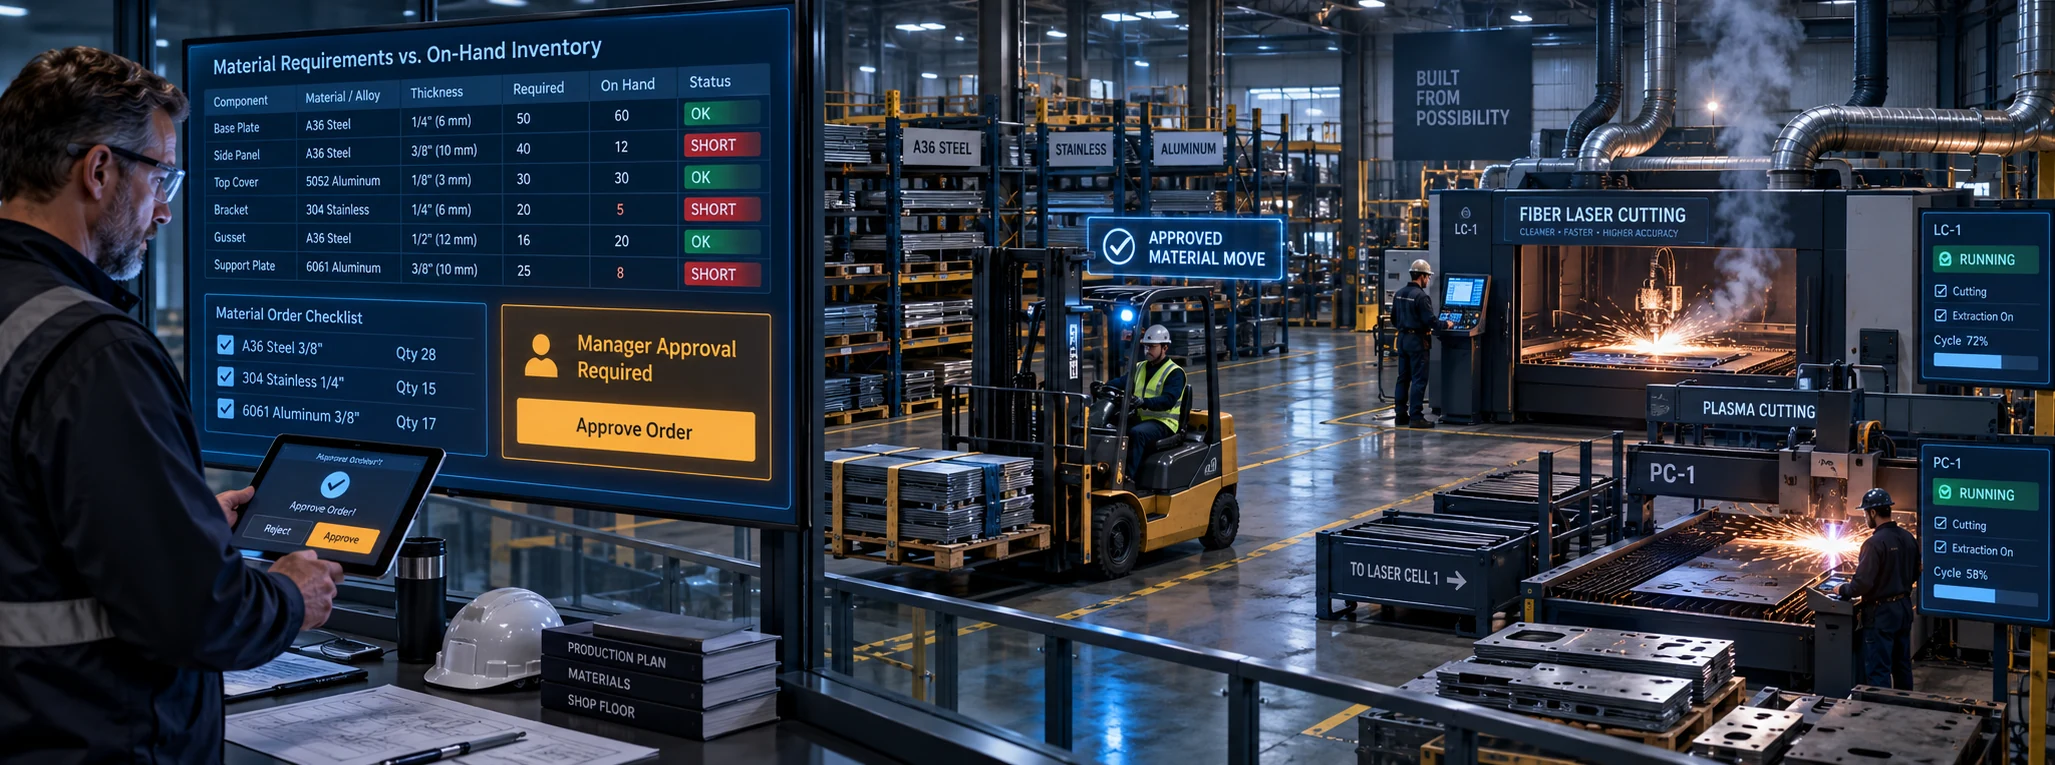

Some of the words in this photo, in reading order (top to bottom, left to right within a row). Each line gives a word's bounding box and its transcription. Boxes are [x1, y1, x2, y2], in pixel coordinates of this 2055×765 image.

[213, 56, 276, 75] Material
[282, 50, 393, 73] Requirements
[399, 51, 421, 64] vs.
[427, 41, 505, 62] On-Hand
[513, 39, 602, 58] Inventory
[601, 80, 618, 91] On
[623, 77, 655, 90] Hand
[690, 76, 731, 88] Status
[1417, 70, 1459, 86] BUILT
[411, 87, 463, 98] Thickness
[514, 81, 564, 97] Required
[214, 96, 268, 108] Component
[306, 91, 345, 103] Material
[348, 90, 353, 102] /
[356, 90, 380, 103] Alloy
[1417, 90, 1459, 105] FROM
[517, 113, 530, 124] 50
[615, 110, 629, 121] 60
[692, 107, 710, 119] OK
[1417, 109, 1509, 126] POSSIBILITY
[214, 123, 235, 133] Base
[237, 121, 260, 133] Plate
[306, 120, 324, 130] A36
[327, 118, 350, 130] Steel
[436, 116, 445, 128] (6
[448, 114, 471, 127] mm)
[436, 145, 451, 158] (10
[454, 143, 477, 157] mm)
[517, 143, 530, 154] 40
[616, 141, 627, 152] 12
[692, 139, 736, 151] SHORT
[914, 140, 935, 153] A36
[940, 141, 971, 154] STEEL
[1056, 143, 1106, 155] STAINLESS
[1162, 143, 1215, 154] ALUMINUM
[214, 150, 233, 160] Side
[236, 149, 260, 160] Panel
[306, 148, 324, 158] A36
[327, 147, 350, 158] Steel
[307, 176, 329, 186] 5052
[332, 175, 380, 186] Aluminum
[435, 174, 445, 187] (3
[448, 174, 471, 187] mm)
[517, 173, 530, 184] 30
[615, 172, 628, 184] 30
[692, 171, 710, 183] OK
[214, 177, 230, 190] Top
[233, 177, 258, 187] Cover
[215, 204, 248, 215] Bracket
[307, 204, 323, 215] 304
[327, 204, 369, 215] Stainless
[436, 204, 445, 217] (6
[448, 204, 471, 217] mm)
[517, 204, 530, 215] 20
[618, 204, 623, 215] 5
[692, 203, 736, 215] SHORT
[1521, 207, 1561, 221] FIBER
[1567, 207, 1613, 222] LASER
[1619, 207, 1685, 222] CUTTING
[1455, 224, 1476, 234] LC-1
[1520, 228, 1555, 236] CLEANER
[1564, 228, 1593, 236] FASTER
[1603, 229, 1633, 237] HIGHER
[1635, 229, 1678, 237] ACCURACY
[1934, 224, 1960, 235] LC-1
[214, 232, 245, 242] Gusset
[306, 233, 324, 243] A36
[328, 233, 351, 243] Steel
[436, 234, 451, 246] (12
[454, 234, 477, 247] mm)
[518, 234, 530, 245] 16
[615, 235, 629, 247] 20
[692, 235, 710, 248] OK
[1149, 231, 1222, 245] APPROVED
[1150, 250, 1219, 265] MATERIAL
[1224, 252, 1265, 266] MOVE
[1961, 254, 2015, 265] RUNNING
[215, 259, 250, 272] Support
[253, 260, 275, 271] Plate
[307, 261, 328, 272] 6061
[332, 262, 381, 273] Aluminum
[436, 263, 451, 276] (10
[455, 264, 477, 277] mm)
[518, 265, 530, 276] 25
[617, 267, 624, 278] 8
[692, 268, 736, 280] SHORT
[1953, 286, 1986, 298] Cutting
[217, 306, 263, 320] Material
[268, 308, 302, 321] Order
[306, 310, 362, 324] Checklist
[1953, 311, 1998, 321] Extraction
[2001, 312, 2013, 321] On
[578, 335, 652, 357] Manager
[657, 338, 736, 359] Approval
[1934, 335, 1961, 347] Cycle
[1967, 336, 1988, 346] 72%
[242, 340, 263, 352] A36
[267, 341, 294, 353] Steel
[299, 342, 322, 355] 3/8"
[397, 347, 418, 362] Qty
[421, 348, 436, 360] 28
[579, 361, 652, 383] Required
[243, 372, 263, 384] 304
[267, 373, 317, 388] Stainless
[321, 376, 344, 389] 1/4"
[397, 380, 418, 397] Qty
[422, 382, 436, 395] 15
[243, 405, 268, 417] 6061
[273, 406, 330, 422] Aluminum
[335, 411, 359, 424] 3/8"
[1704, 401, 1755, 416] PLASMA
[1760, 403, 1815, 418] CUTTING
[397, 415, 418, 432] Qty
[422, 417, 436, 430] 17
[577, 418, 641, 438] Approve
[647, 422, 692, 439] Order
[1934, 457, 1960, 469] PC-1
[1651, 463, 1694, 484] PC-1
[1960, 488, 2014, 501] RUNNING
[289, 501, 325, 513] Approve
[264, 524, 291, 535] Reject
[1953, 519, 1986, 532] Cutting
[324, 532, 359, 543] Approve
[1953, 543, 1997, 555] Extraction
[2000, 547, 2013, 556] On
[1350, 562, 1364, 576] TO
[1368, 564, 1401, 581] LASER
[1405, 568, 1430, 584] CELL
[1434, 572, 1438, 585] 1
[1934, 566, 1961, 579] Cycle
[1967, 569, 1988, 580] 58%
[568, 642, 633, 663] PRODUCTION
[638, 654, 665, 668] PLAN
[569, 668, 630, 690] MATERIALS
[568, 694, 596, 709] SHOP
[600, 701, 634, 718] FLOOR
